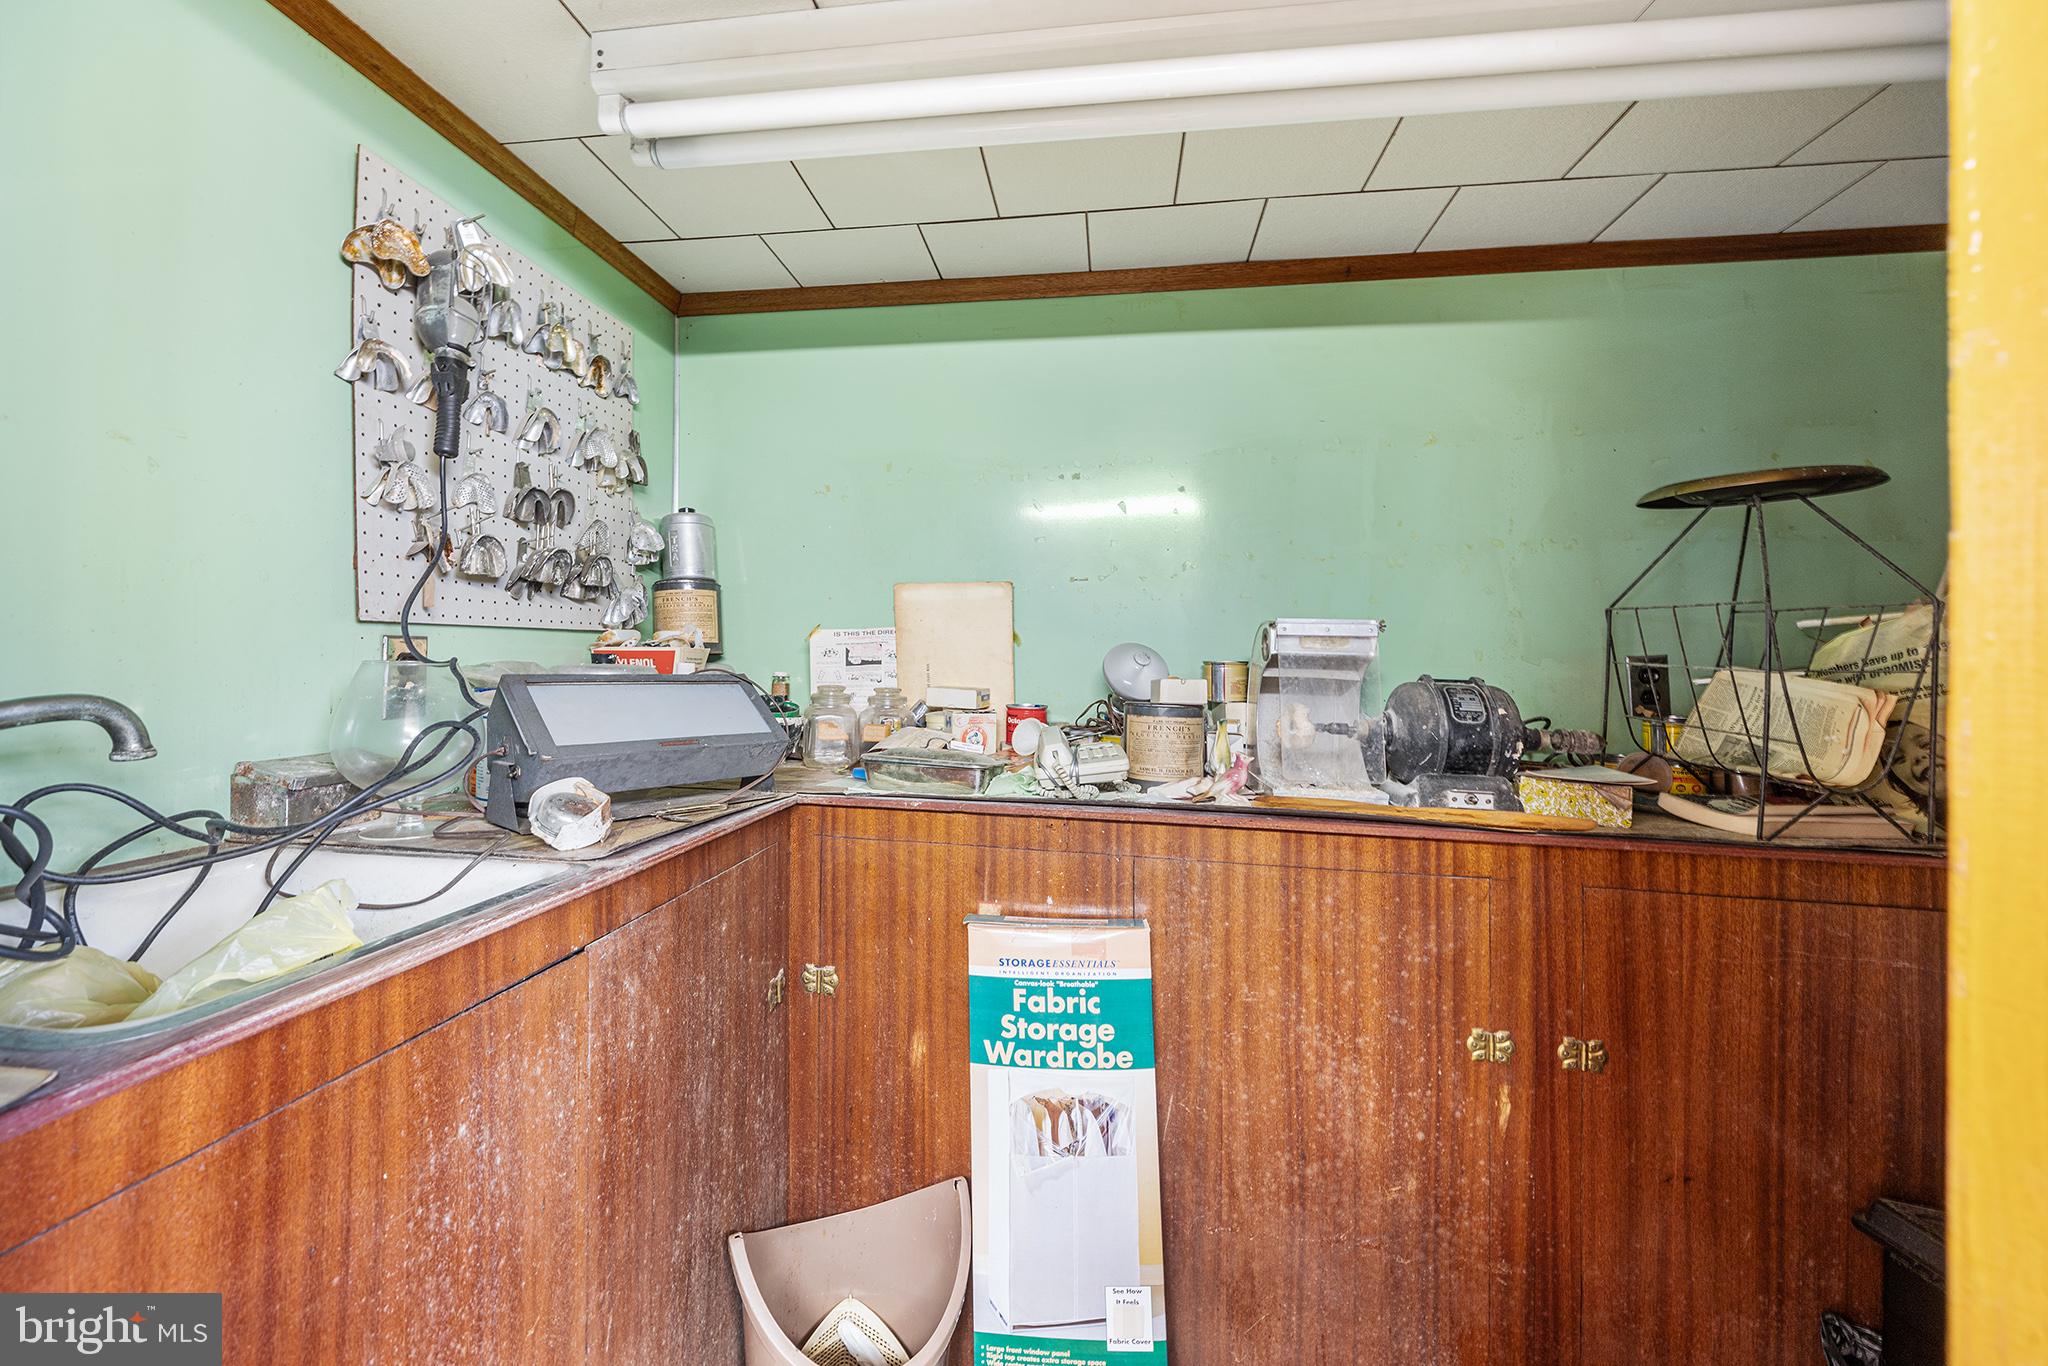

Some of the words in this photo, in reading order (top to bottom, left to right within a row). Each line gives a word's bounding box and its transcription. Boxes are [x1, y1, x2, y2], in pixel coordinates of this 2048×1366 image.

[1890, 650, 1904, 662] up
[1906, 646, 1919, 658] to
[1012, 988, 1101, 1014] Fabric
[1000, 1014, 1116, 1048] Storage
[983, 1039, 1134, 1070] Wardrobe
[1131, 1338, 1152, 1346] Cover
[986, 1344, 1004, 1354] Large
[1006, 1346, 1022, 1354] front
[1023, 1348, 1050, 1356] window
[1052, 1350, 1071, 1358] panel
[986, 1352, 1003, 1361] Rigid
[1004, 1354, 1016, 1362] top
[1016, 1355, 1040, 1363] creates
[1061, 1358, 1086, 1366] storage
